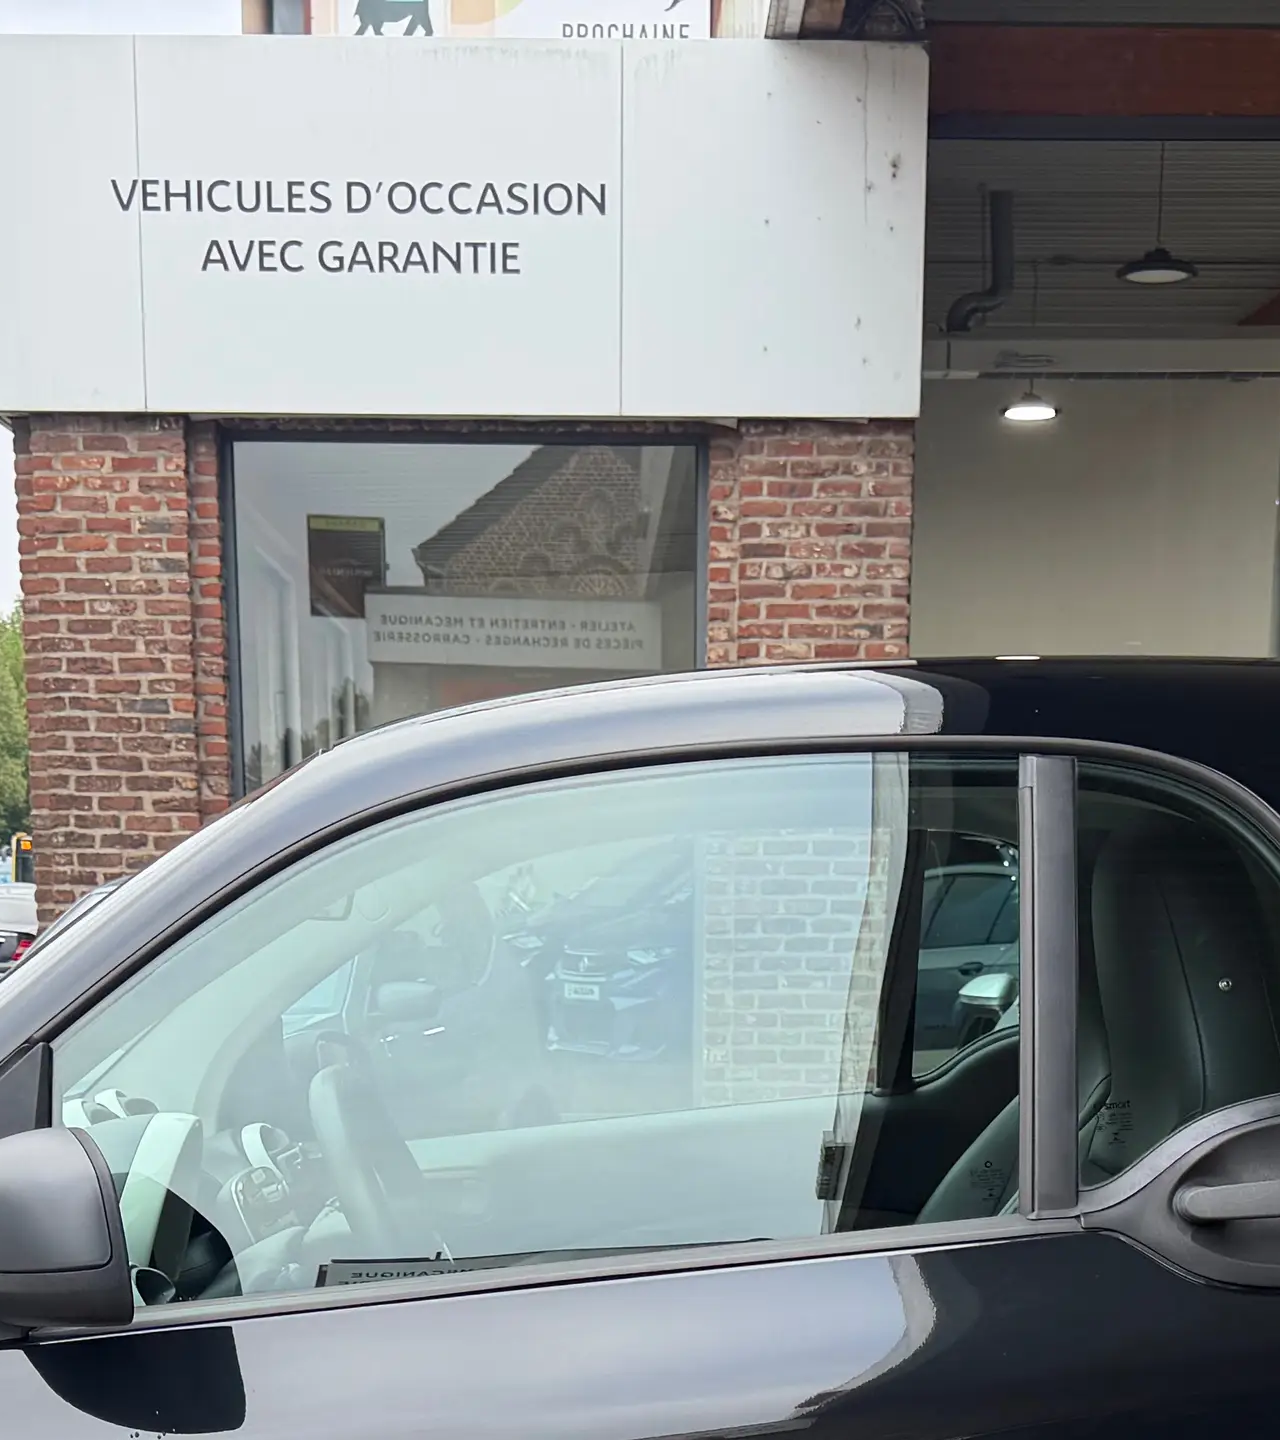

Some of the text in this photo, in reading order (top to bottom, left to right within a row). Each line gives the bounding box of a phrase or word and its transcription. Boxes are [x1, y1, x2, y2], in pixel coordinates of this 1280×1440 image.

[110, 179, 607, 216] VEHICULES D'OCCASION
[201, 239, 522, 274] AVEC GARANTIE
